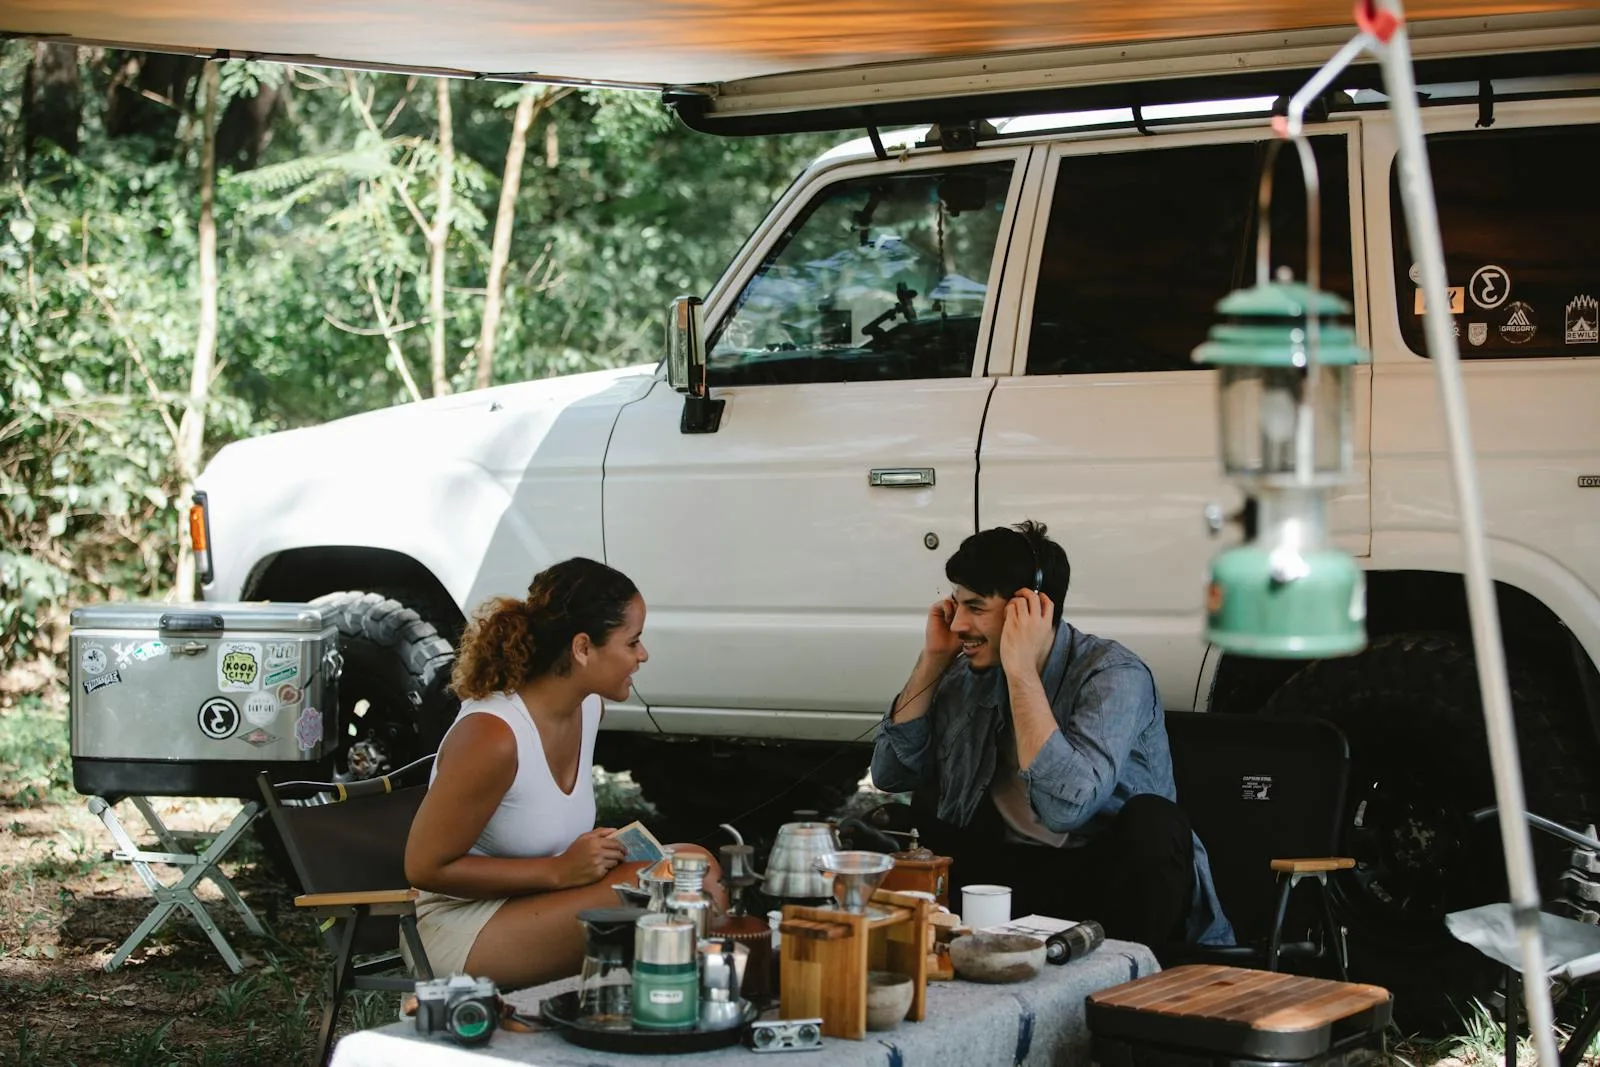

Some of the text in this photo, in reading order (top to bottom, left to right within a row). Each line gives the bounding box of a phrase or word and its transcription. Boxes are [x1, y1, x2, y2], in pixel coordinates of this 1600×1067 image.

[1567, 331, 1597, 339] REWILD
[226, 662, 254, 673] KOOK
[229, 671, 251, 680] CITY
